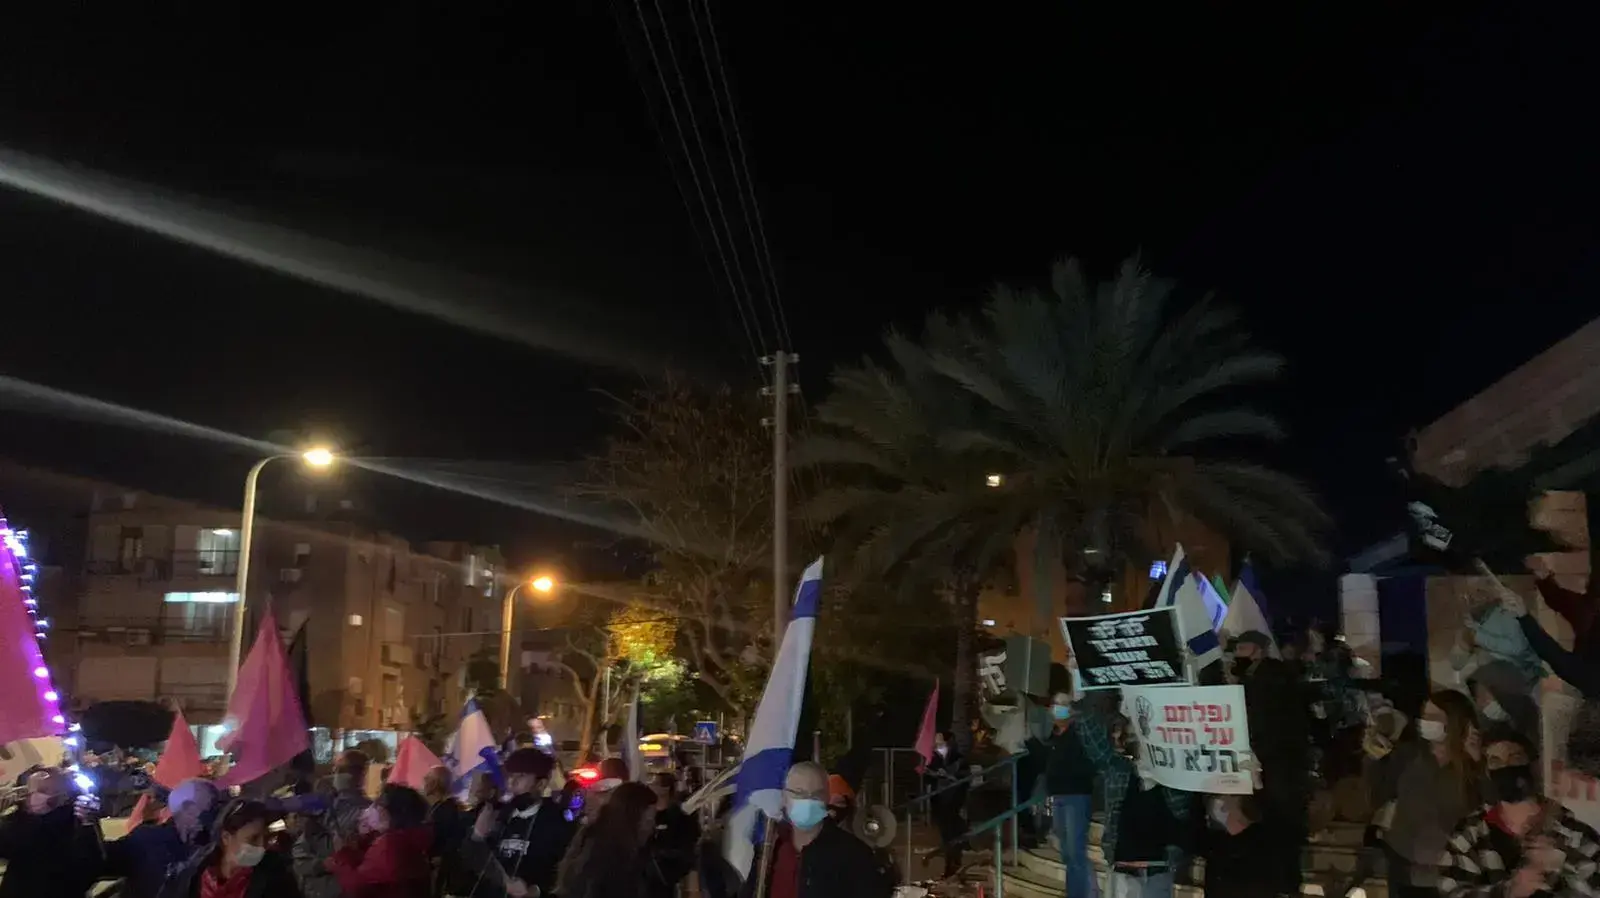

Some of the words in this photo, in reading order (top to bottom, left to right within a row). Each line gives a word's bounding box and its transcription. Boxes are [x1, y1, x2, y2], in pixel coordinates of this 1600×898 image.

[1164, 700, 1232, 723] נפלתם
[1156, 726, 1198, 745] הדור
[1203, 723, 1235, 745] על
[1146, 743, 1176, 769] נכון
[1184, 744, 1240, 773] הלא
